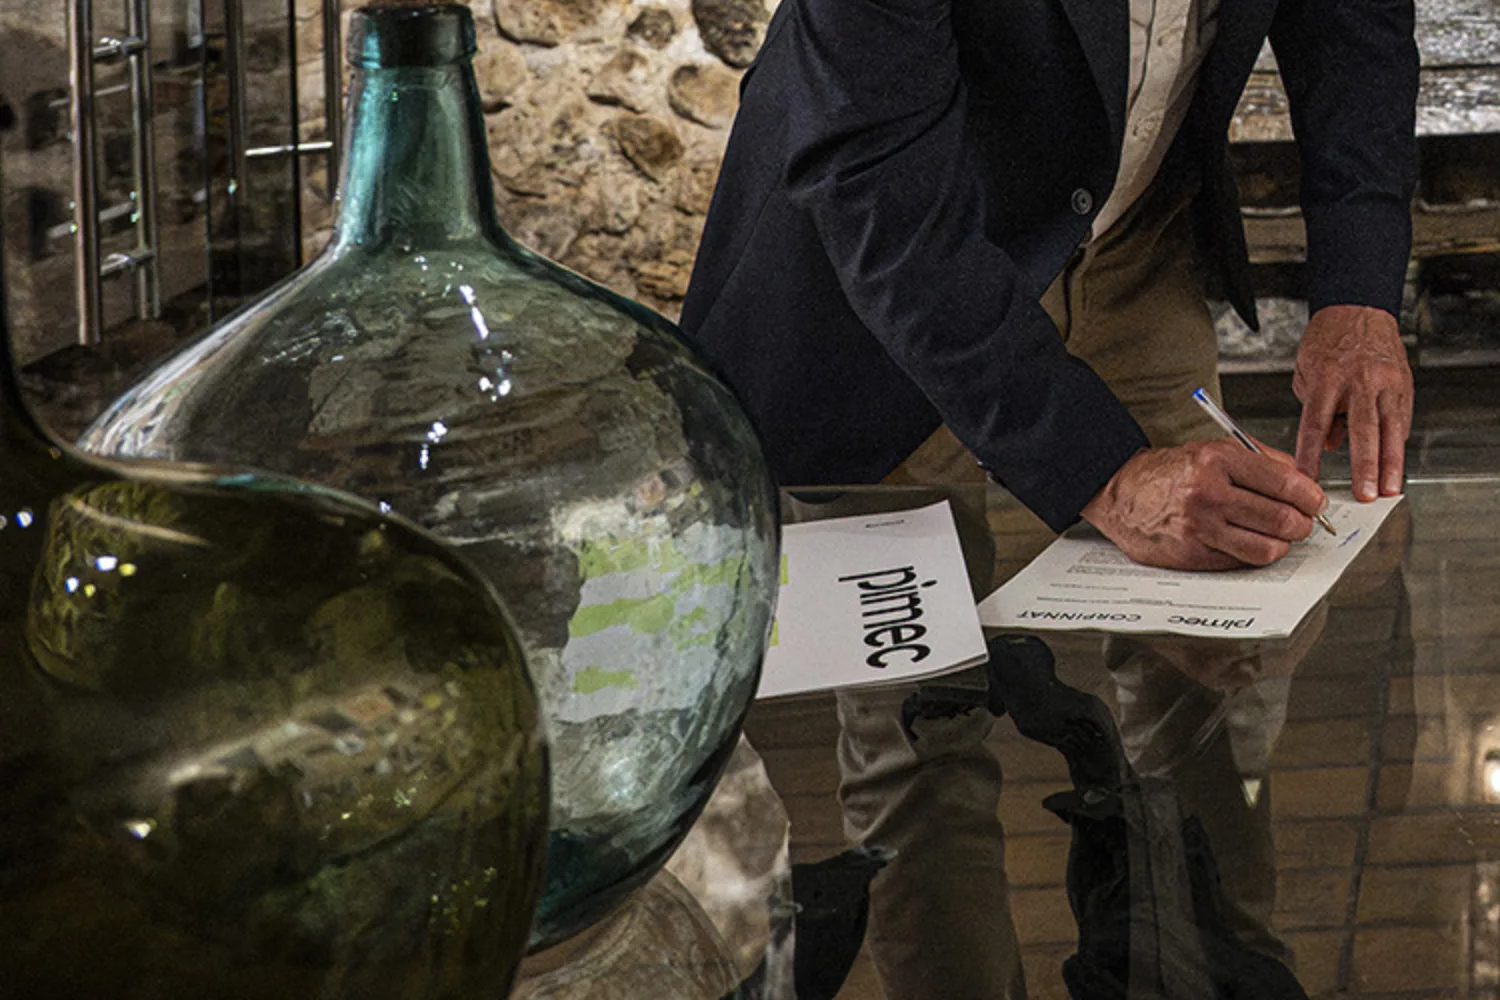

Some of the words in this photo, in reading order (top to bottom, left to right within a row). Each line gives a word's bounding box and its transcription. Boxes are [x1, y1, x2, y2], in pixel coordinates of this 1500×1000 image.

[838, 565, 938, 669] pimec
[1016, 608, 1142, 623] CORPINNAT
[1167, 614, 1255, 629] pimec
